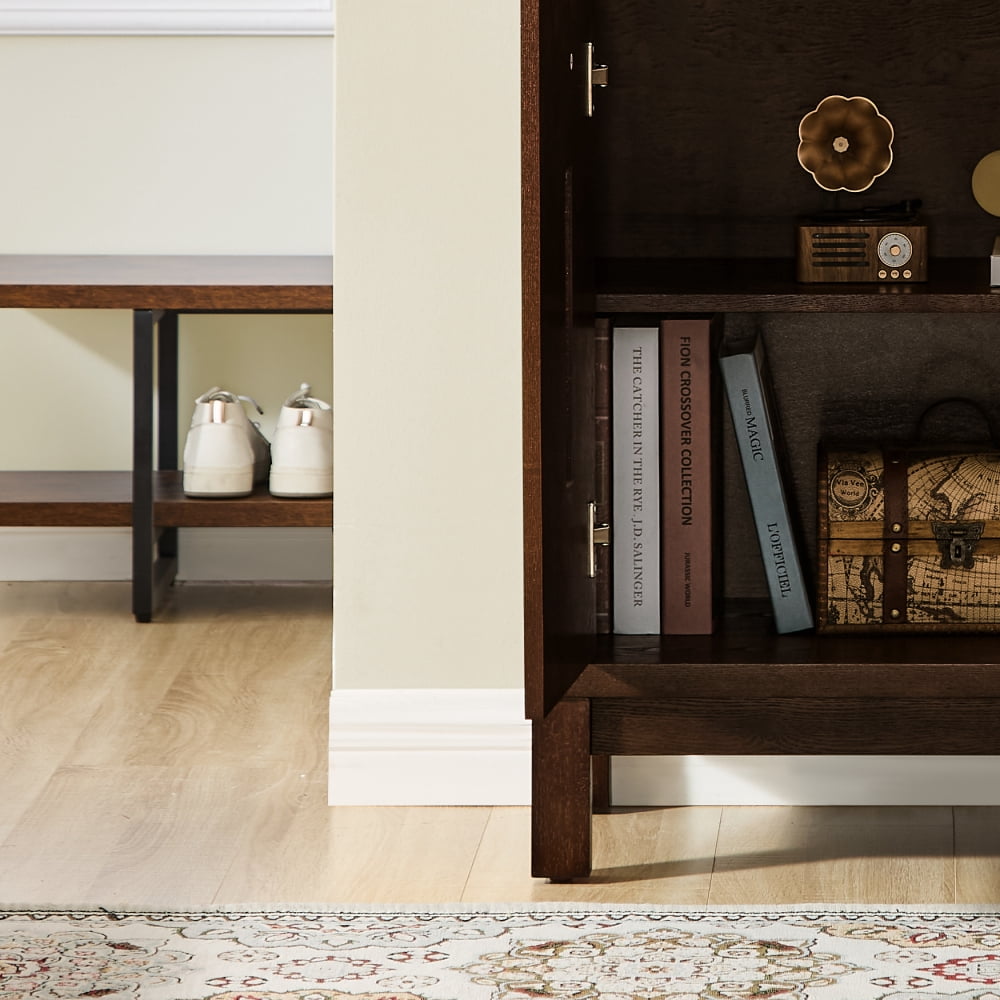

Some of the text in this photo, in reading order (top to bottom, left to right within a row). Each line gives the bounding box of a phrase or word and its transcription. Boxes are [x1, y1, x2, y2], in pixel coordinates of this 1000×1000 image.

[632, 346, 643, 374] THE
[632, 376, 643, 438] CATCHER
[632, 441, 643, 456] IN
[679, 336, 693, 526] FION CROSSOVER COLLECTION
[745, 416, 764, 463] MAGIC
[632, 457, 643, 486] THE
[632, 488, 643, 512] RYE
[632, 542, 643, 608] SALINGER
[767, 522, 791, 599] L'OFFICIEL
